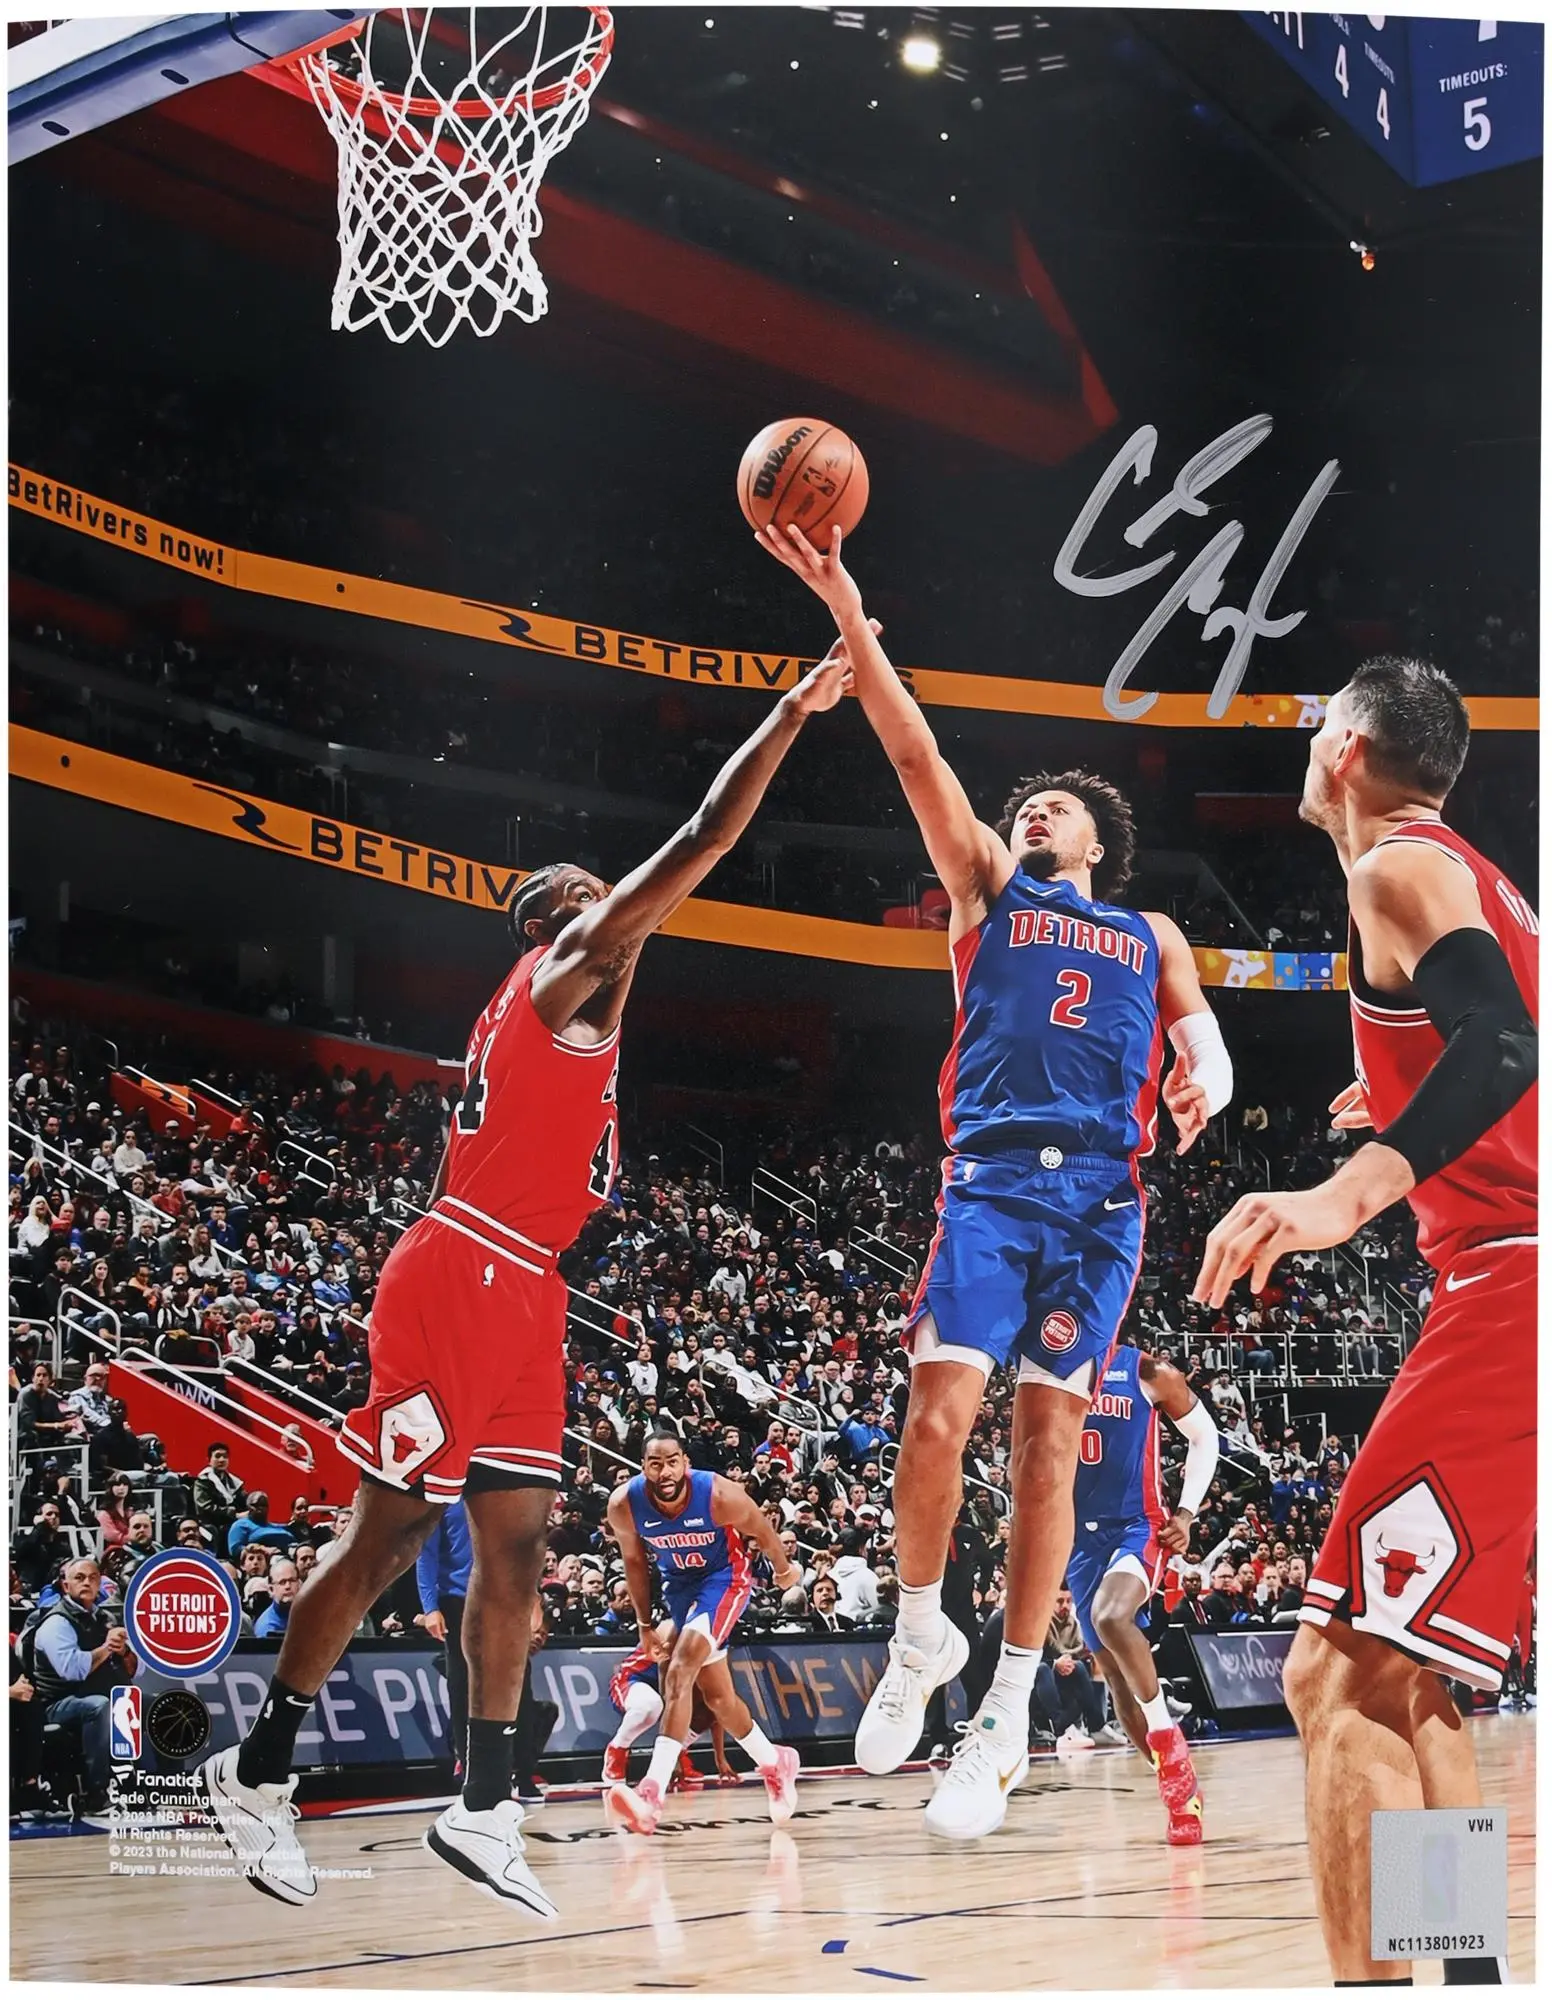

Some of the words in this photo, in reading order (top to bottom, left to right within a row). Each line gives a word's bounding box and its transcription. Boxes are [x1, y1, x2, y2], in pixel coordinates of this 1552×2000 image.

[1335, 44, 1349, 98] 4
[1439, 63, 1508, 92] TIMEOUTS:
[1377, 88, 1390, 140] 4
[1463, 97, 1491, 151] 5
[8, 469, 147, 546] BetRivers
[160, 532, 224, 575] now!
[311, 818, 519, 907] BETRIV
[1009, 910, 1148, 976] DETROIT
[1050, 969, 1091, 1029] 2
[672, 1552, 707, 1569] 14
[731, 1658, 843, 1720] THE
[1468, 1819, 1493, 1832] VVH
[1388, 1935, 1485, 1951] NC113801923
